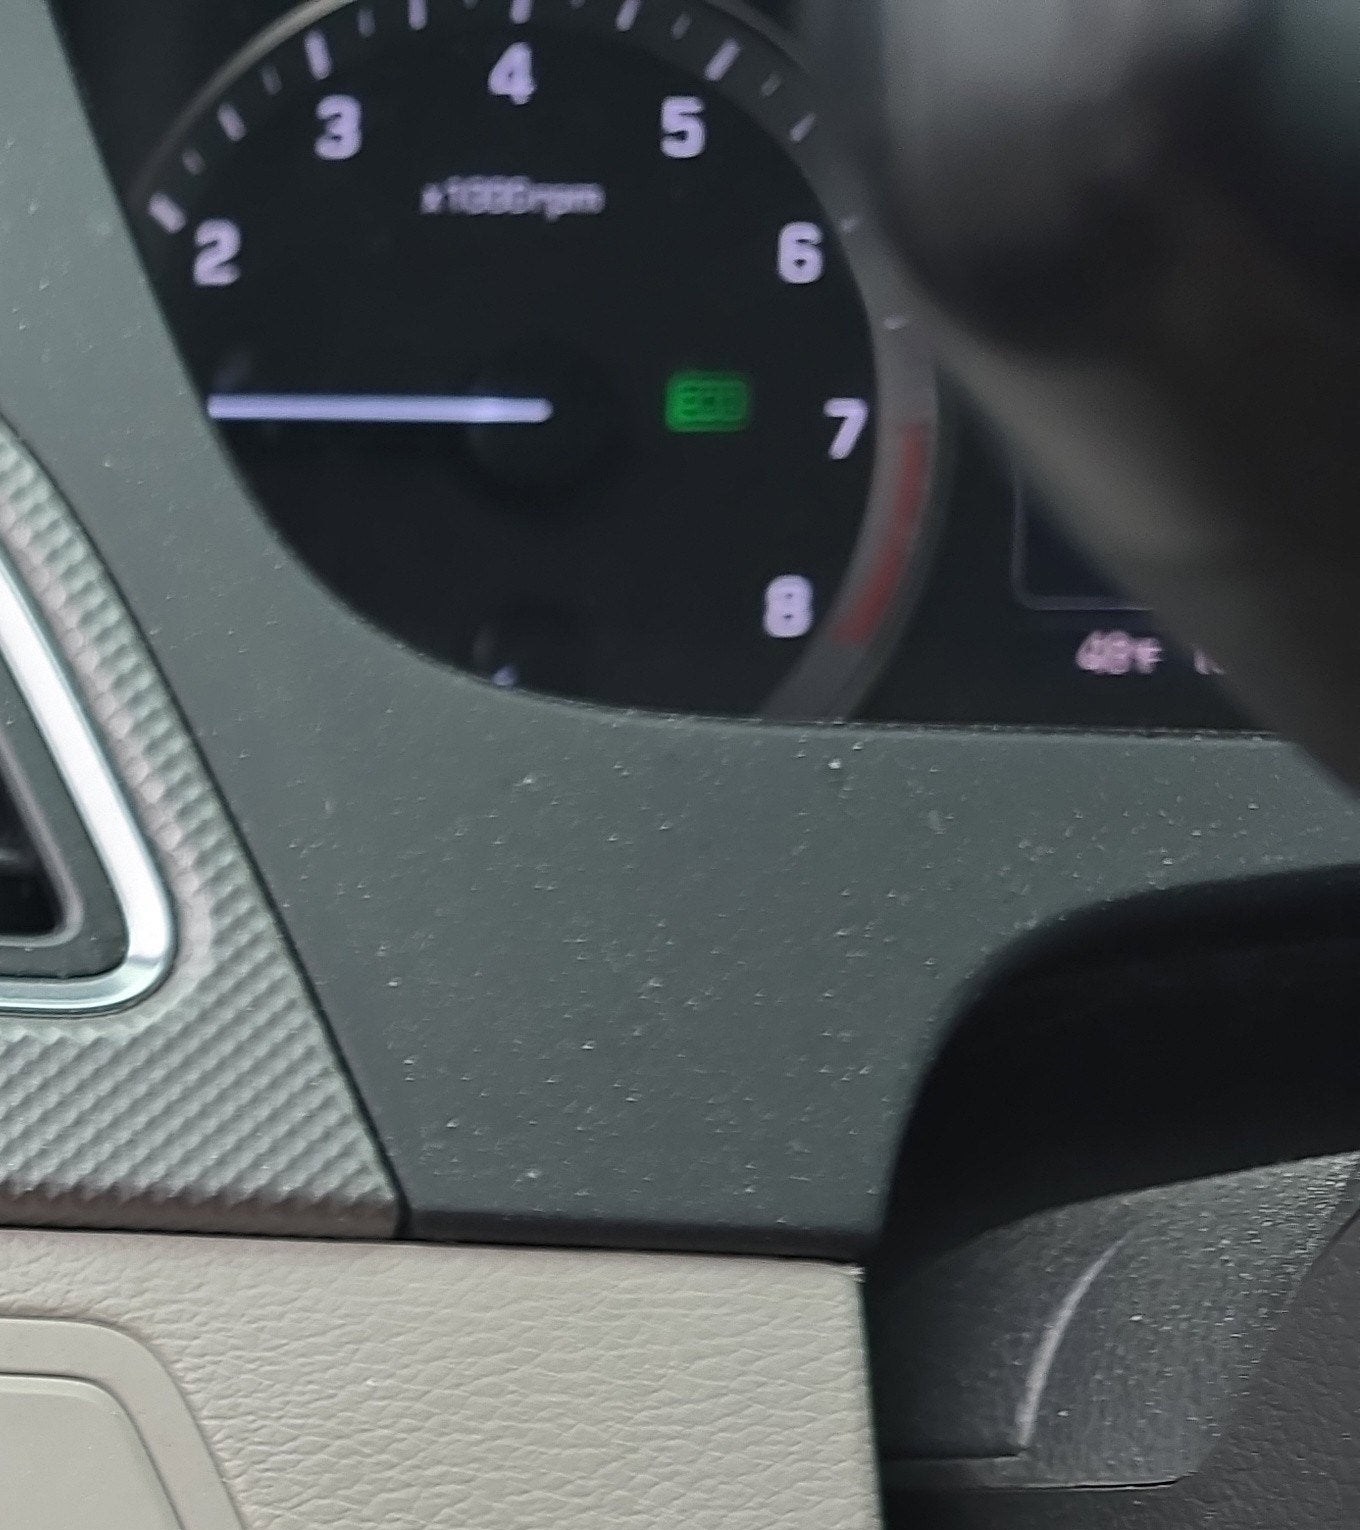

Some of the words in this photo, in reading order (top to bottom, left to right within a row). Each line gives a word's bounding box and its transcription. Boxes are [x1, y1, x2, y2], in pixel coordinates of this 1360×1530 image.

[488, 42, 535, 105] 4
[315, 95, 362, 160] 3
[660, 96, 707, 159] 5
[193, 219, 241, 286] 2
[777, 221, 824, 284] 6
[823, 397, 869, 460] 7
[763, 574, 814, 638] 8
